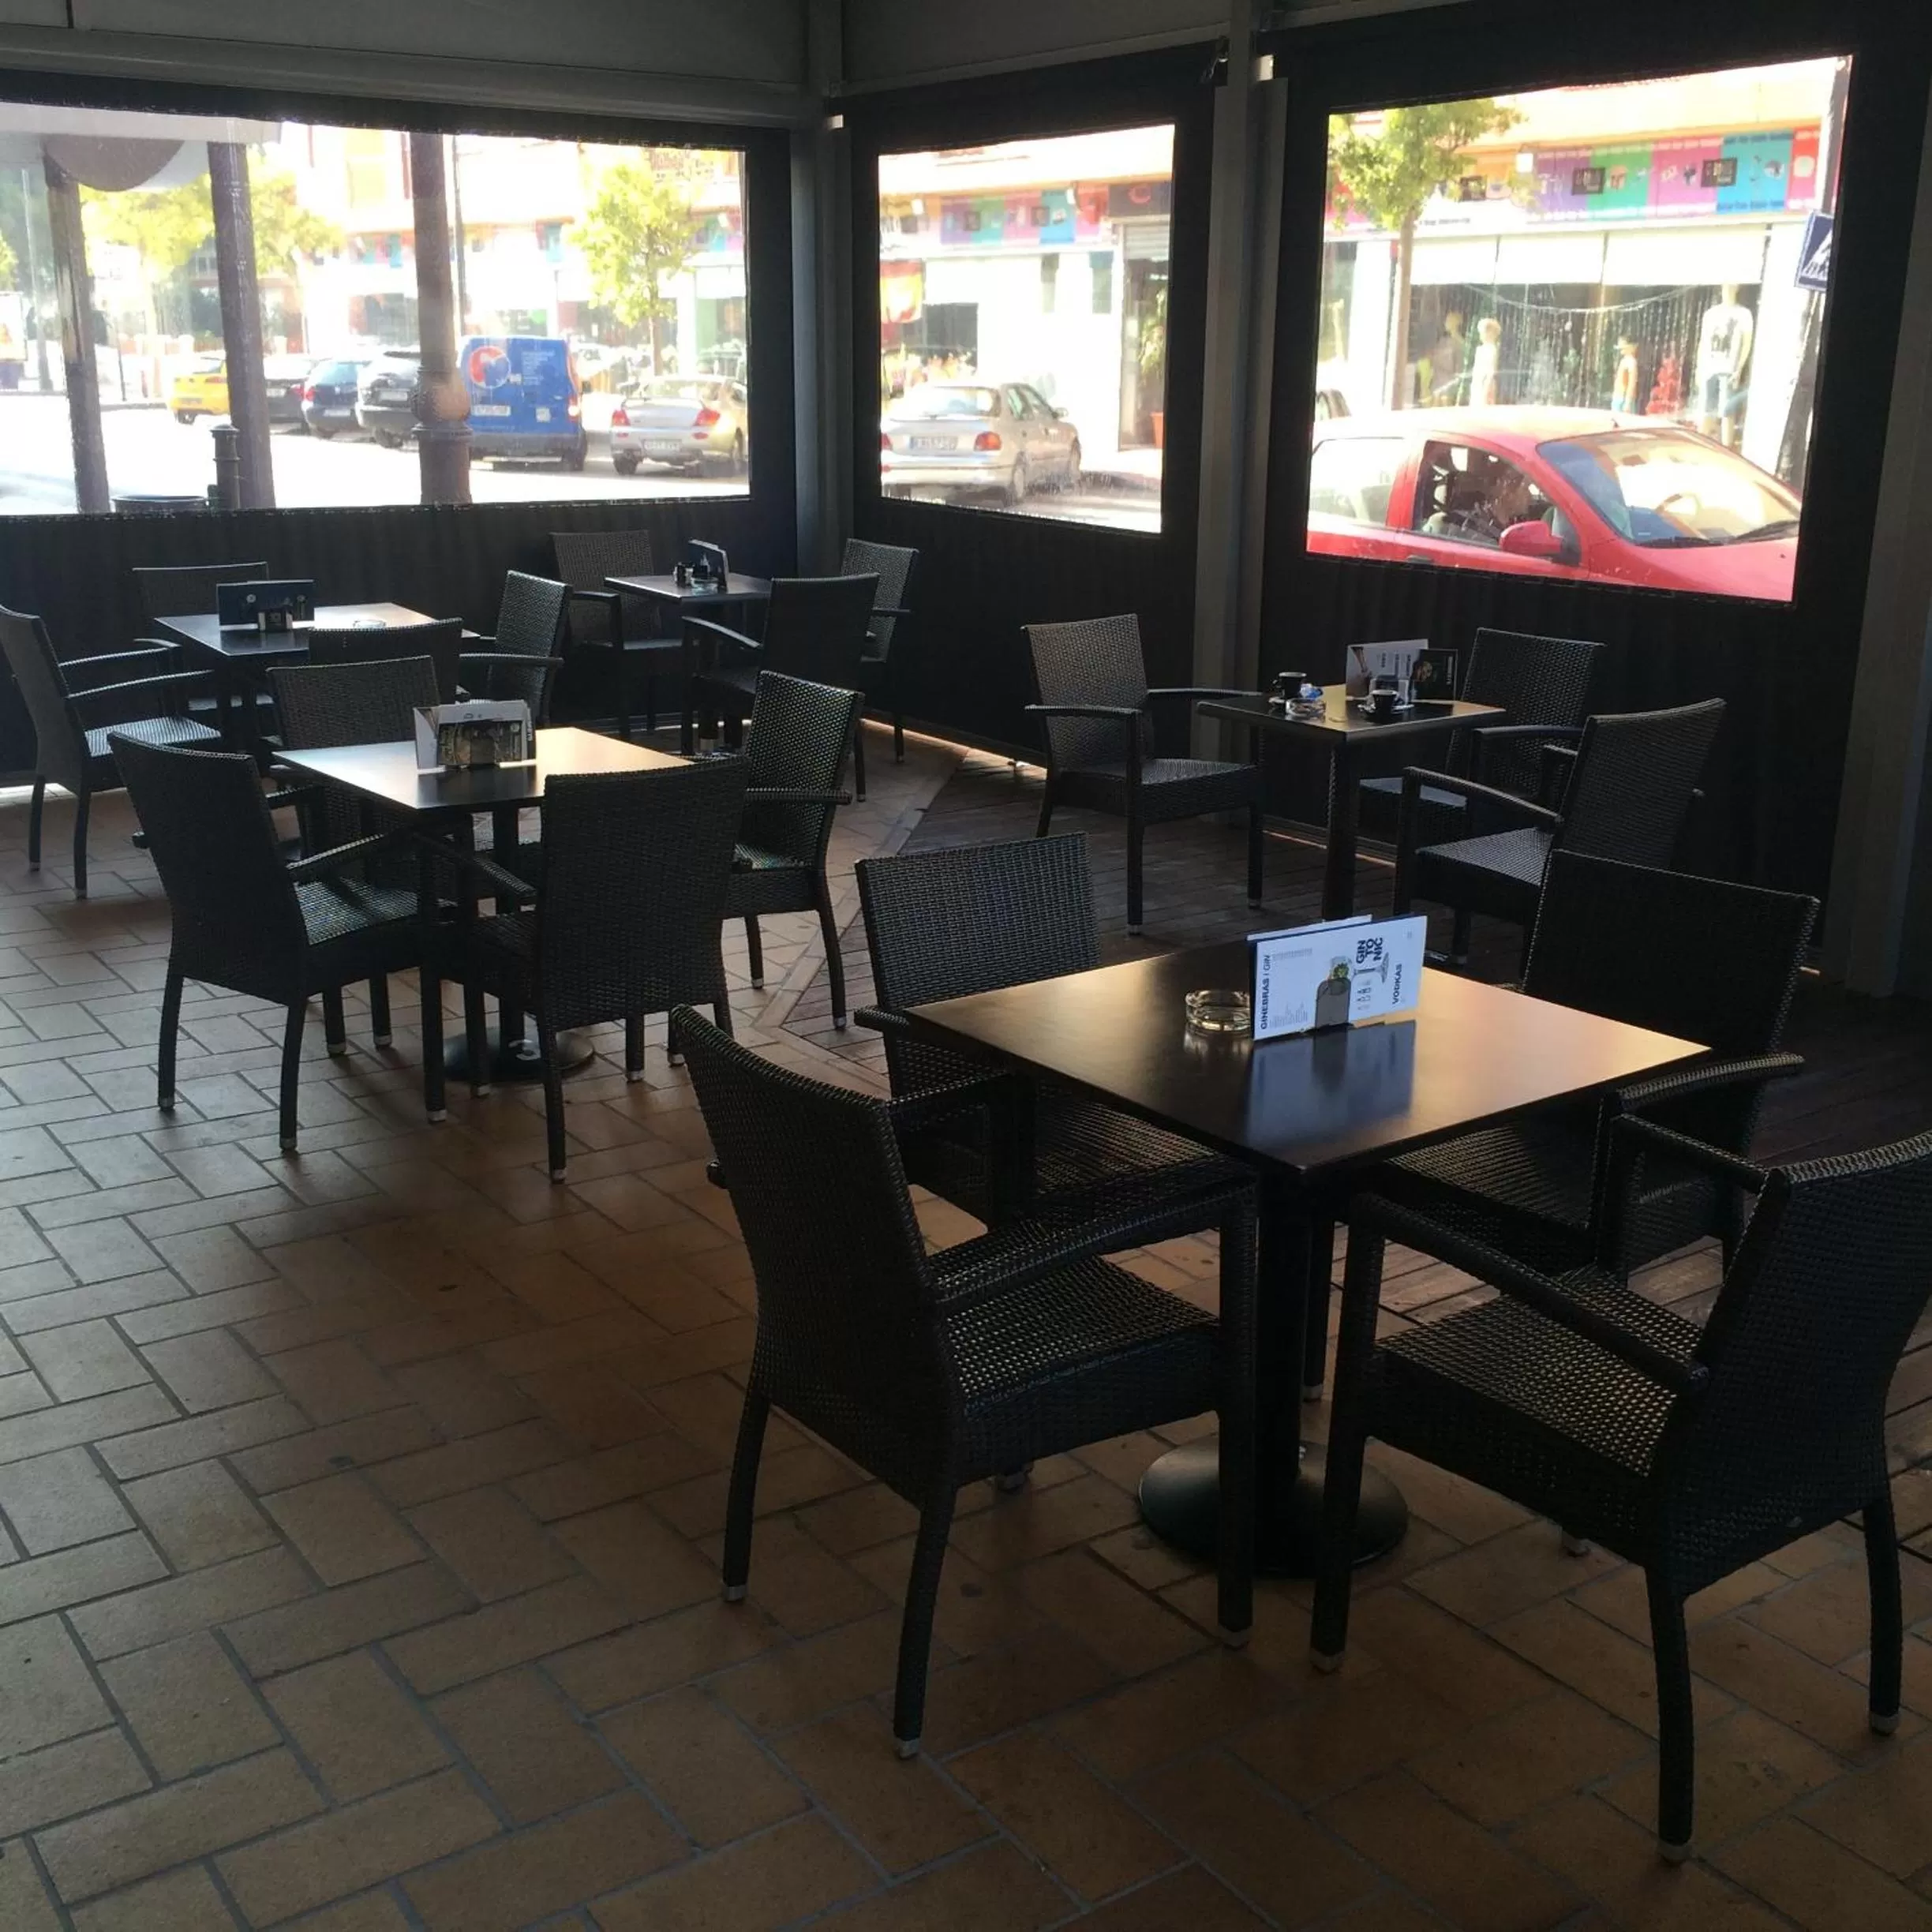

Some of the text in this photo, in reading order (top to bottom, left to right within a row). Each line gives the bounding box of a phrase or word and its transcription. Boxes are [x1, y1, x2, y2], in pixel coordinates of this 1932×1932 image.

[1356, 940, 1366, 964] GIN
[1365, 938, 1375, 958] TO
[1373, 937, 1383, 961] NIC
[1391, 964, 1402, 1005] VODKAS
[1260, 978, 1270, 1030] GINEBRAS
